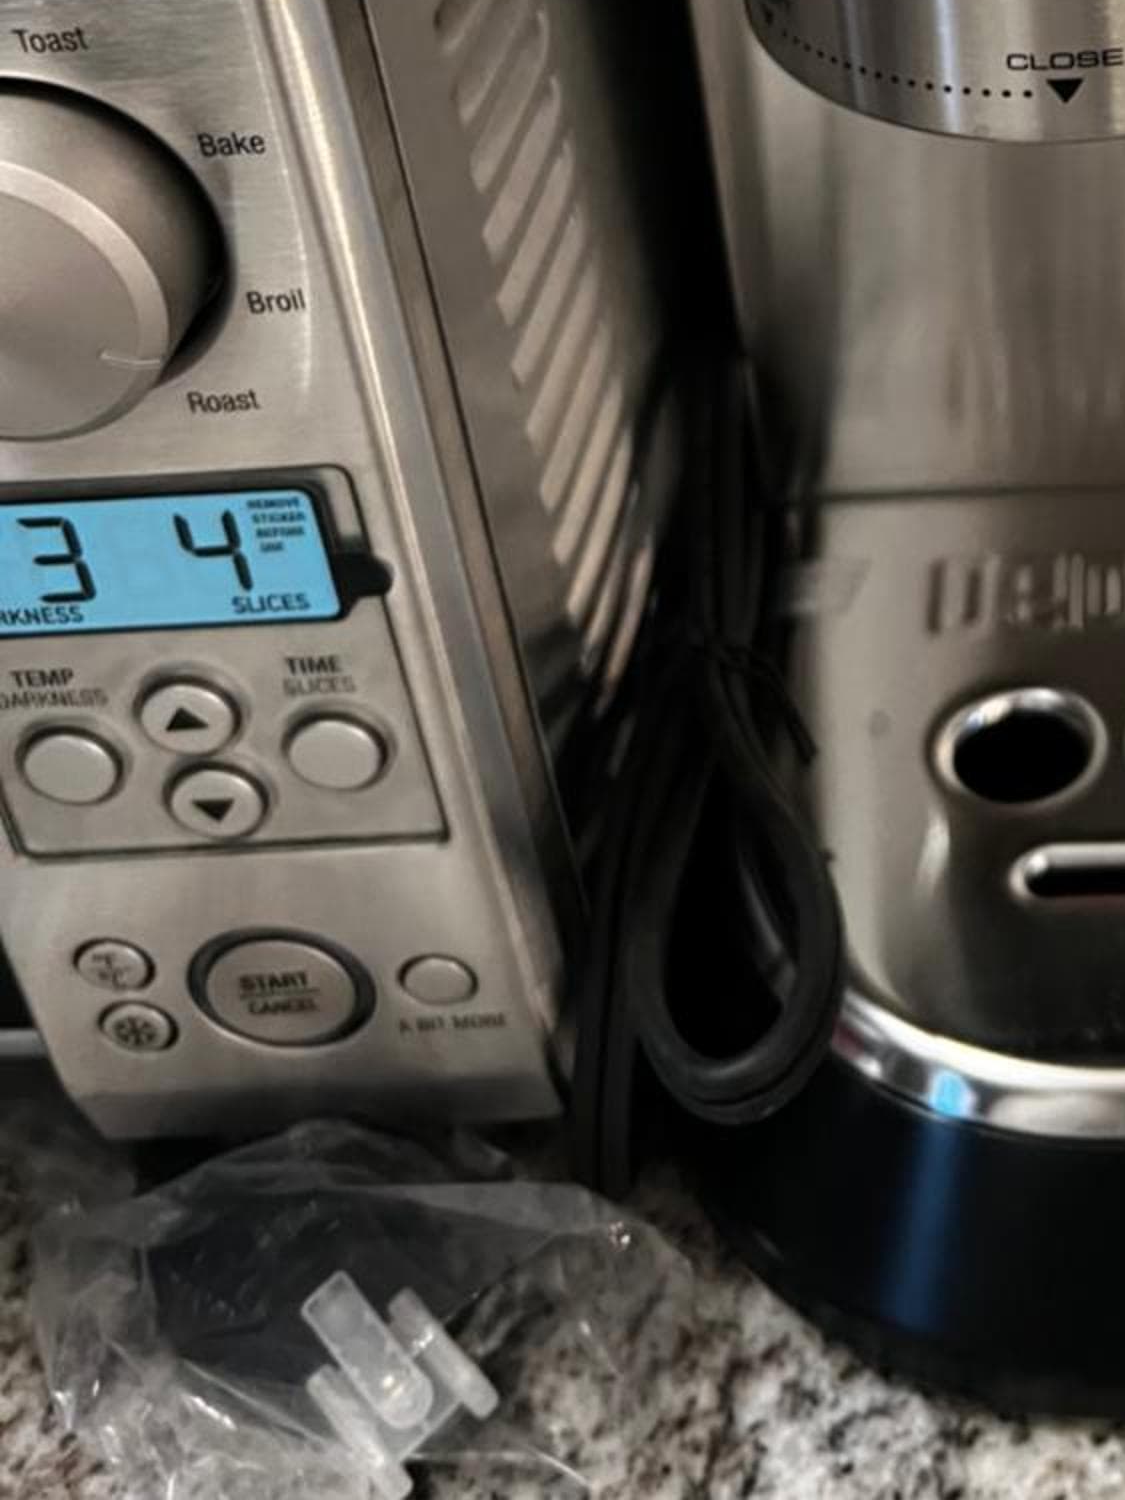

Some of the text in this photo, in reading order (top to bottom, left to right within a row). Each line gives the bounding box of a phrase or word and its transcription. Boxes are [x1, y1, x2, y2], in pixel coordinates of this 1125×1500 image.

[13, 25, 88, 55] Toast
[1006, 47, 1124, 71] CLOSE
[197, 132, 266, 158] Bake
[246, 289, 306, 315] Broil
[186, 390, 260, 414] Roast
[16, 516, 97, 602] 3
[172, 509, 254, 591] 4
[232, 593, 311, 614] SLICES
[284, 655, 343, 675] TIME
[10, 667, 74, 688] TEMP
[239, 970, 308, 992] START
